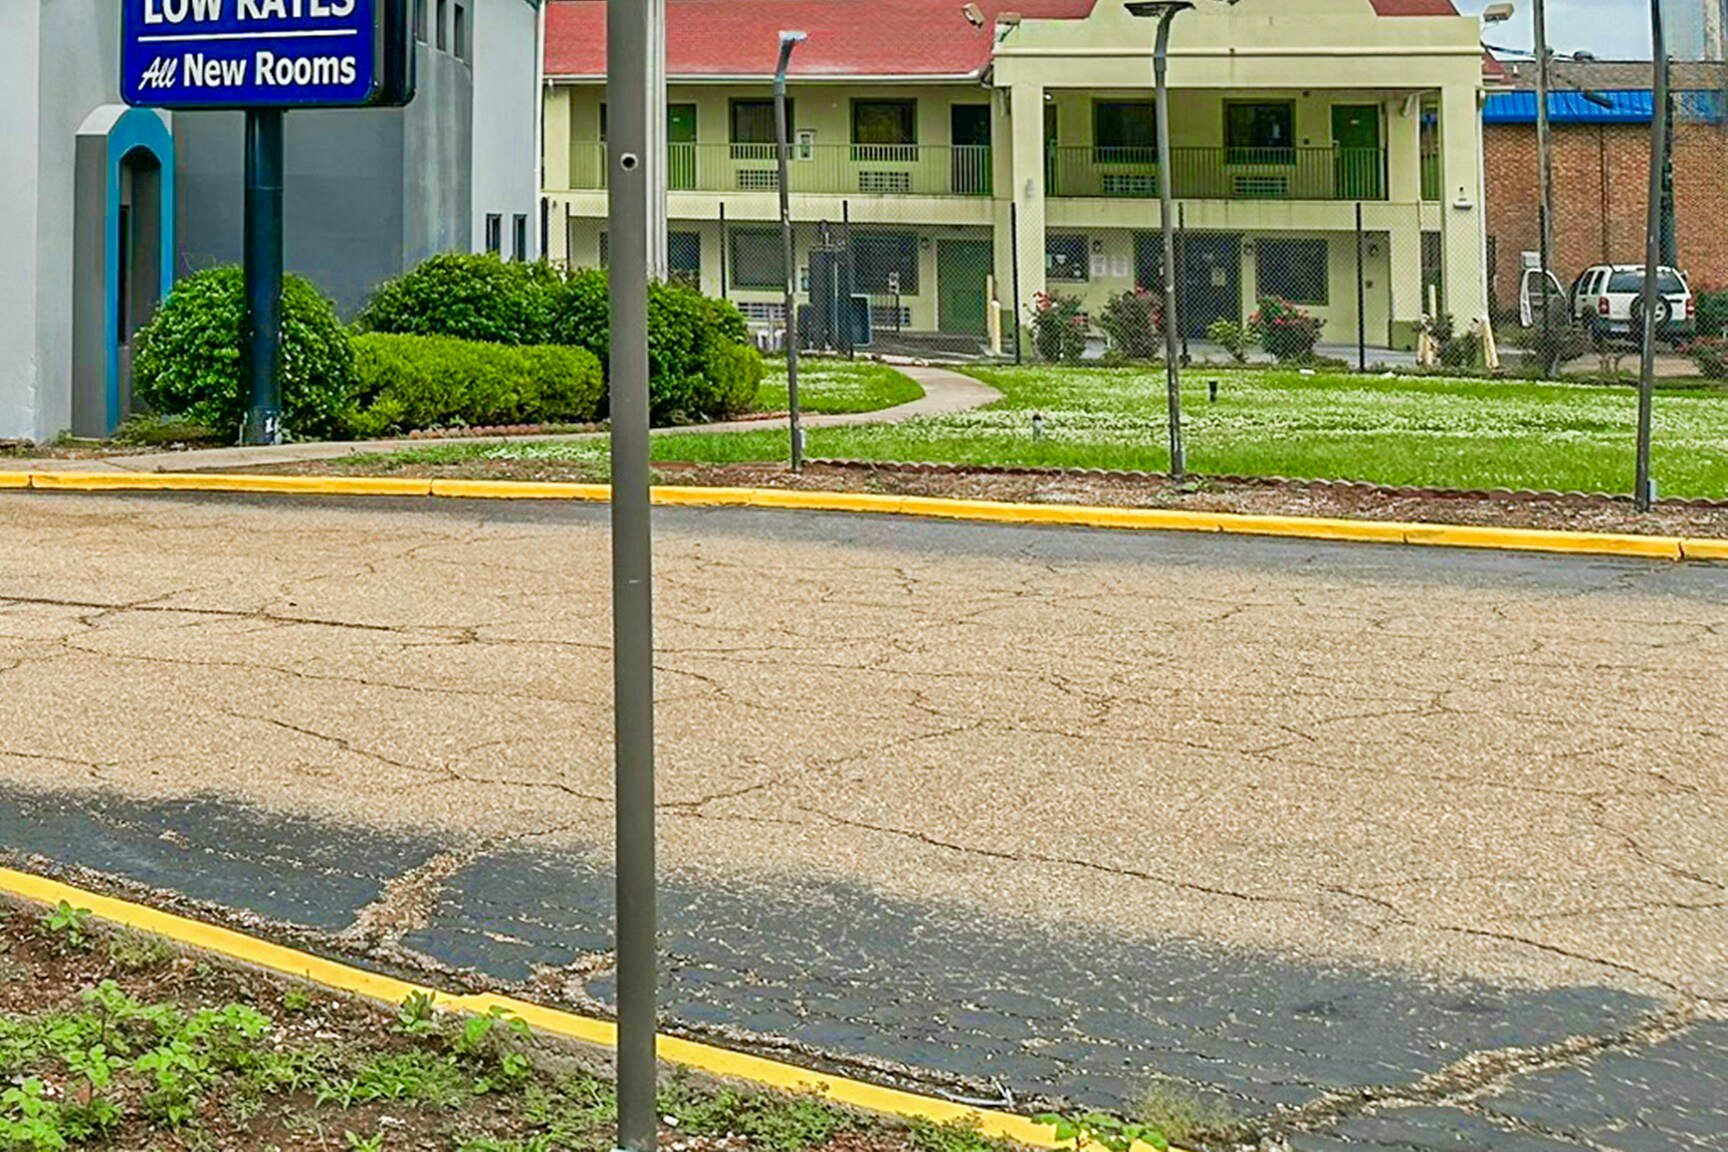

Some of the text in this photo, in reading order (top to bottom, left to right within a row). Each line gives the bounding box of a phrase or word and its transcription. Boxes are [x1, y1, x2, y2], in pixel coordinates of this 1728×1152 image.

[138, 51, 357, 90] All New Rooms
